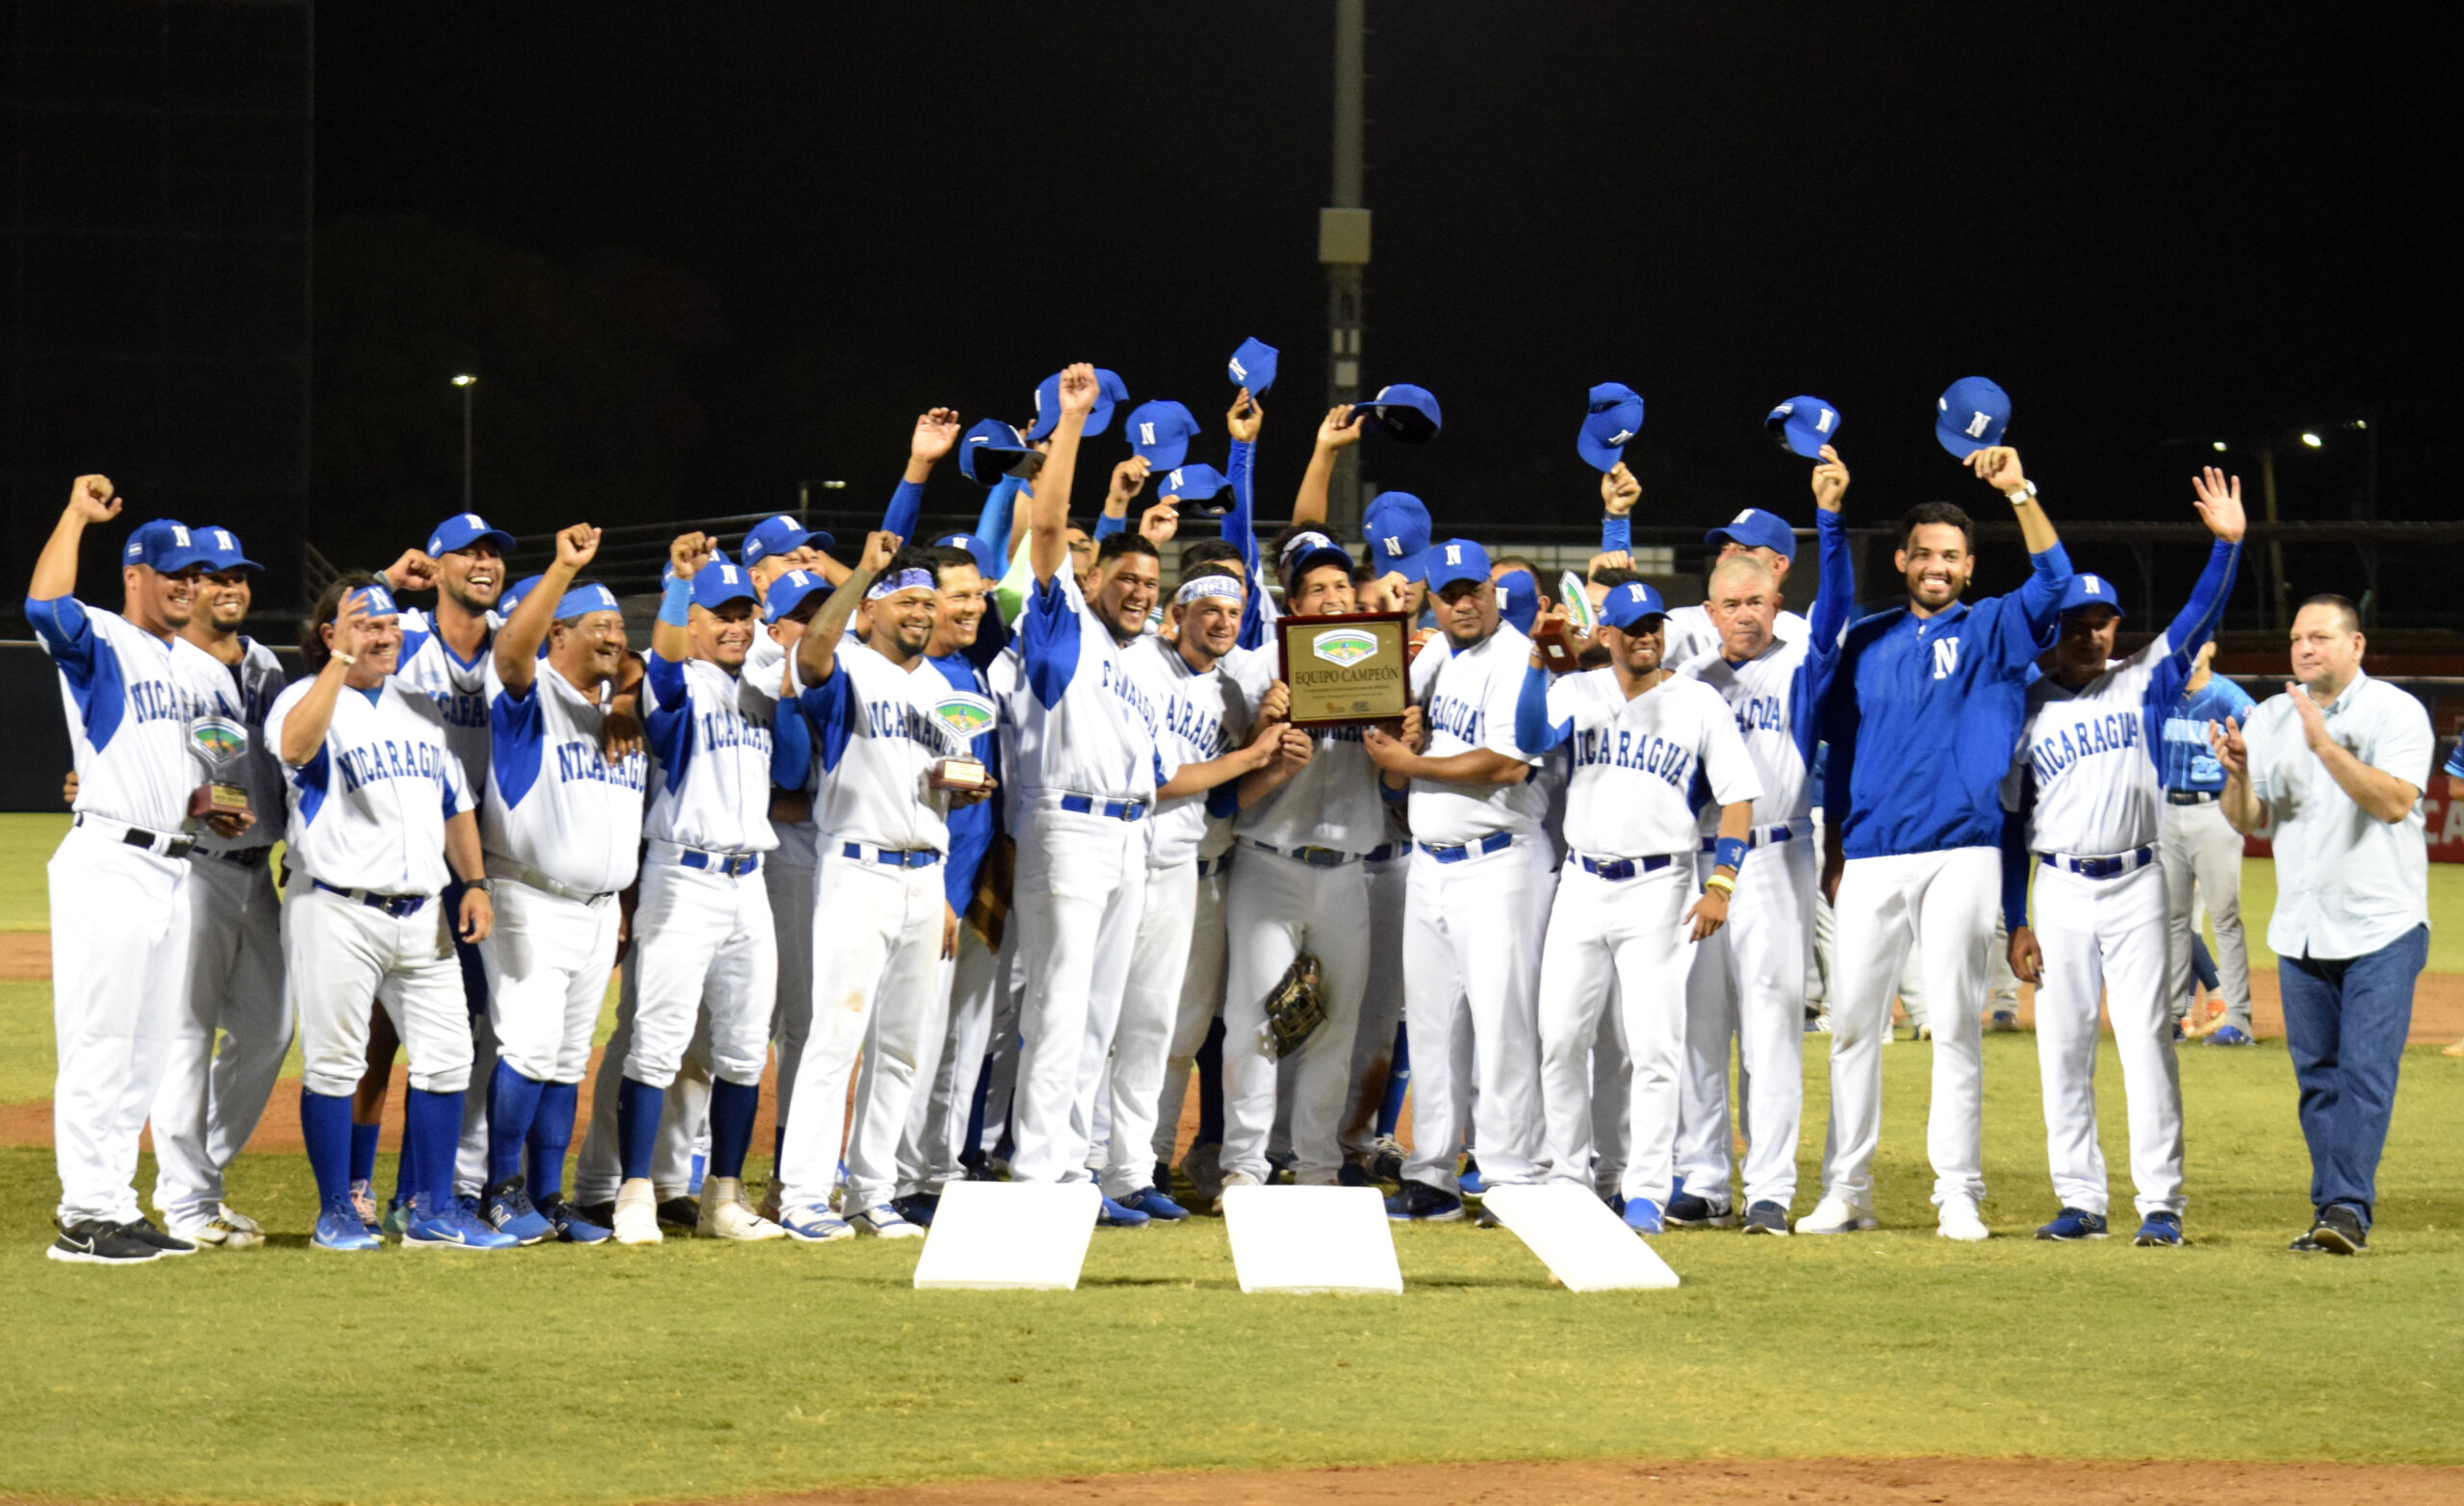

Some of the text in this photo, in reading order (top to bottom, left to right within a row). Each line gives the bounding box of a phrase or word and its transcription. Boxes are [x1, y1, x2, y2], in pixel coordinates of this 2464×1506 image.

[1228, 357, 1247, 381] N
[1815, 408, 1834, 433] N
[1964, 411, 1991, 439] N
[1140, 421, 1156, 446] N
[1168, 468, 1184, 491] N
[465, 514, 485, 529] N
[779, 515, 802, 531] N
[171, 525, 192, 547] N
[214, 530, 234, 550] N
[1383, 536, 1403, 556] N
[1445, 545, 1462, 566] N
[720, 564, 739, 584] N
[787, 570, 810, 588] N
[596, 585, 618, 606] N
[1628, 583, 1647, 602] N
[2082, 575, 2100, 595] N
[368, 587, 393, 612] N
[1496, 587, 1509, 610] N
[1933, 636, 1960, 679] N
[1296, 665, 1399, 686] EQUIPO CAMPEÓN
[2029, 711, 2139, 786] NICARAGUA
